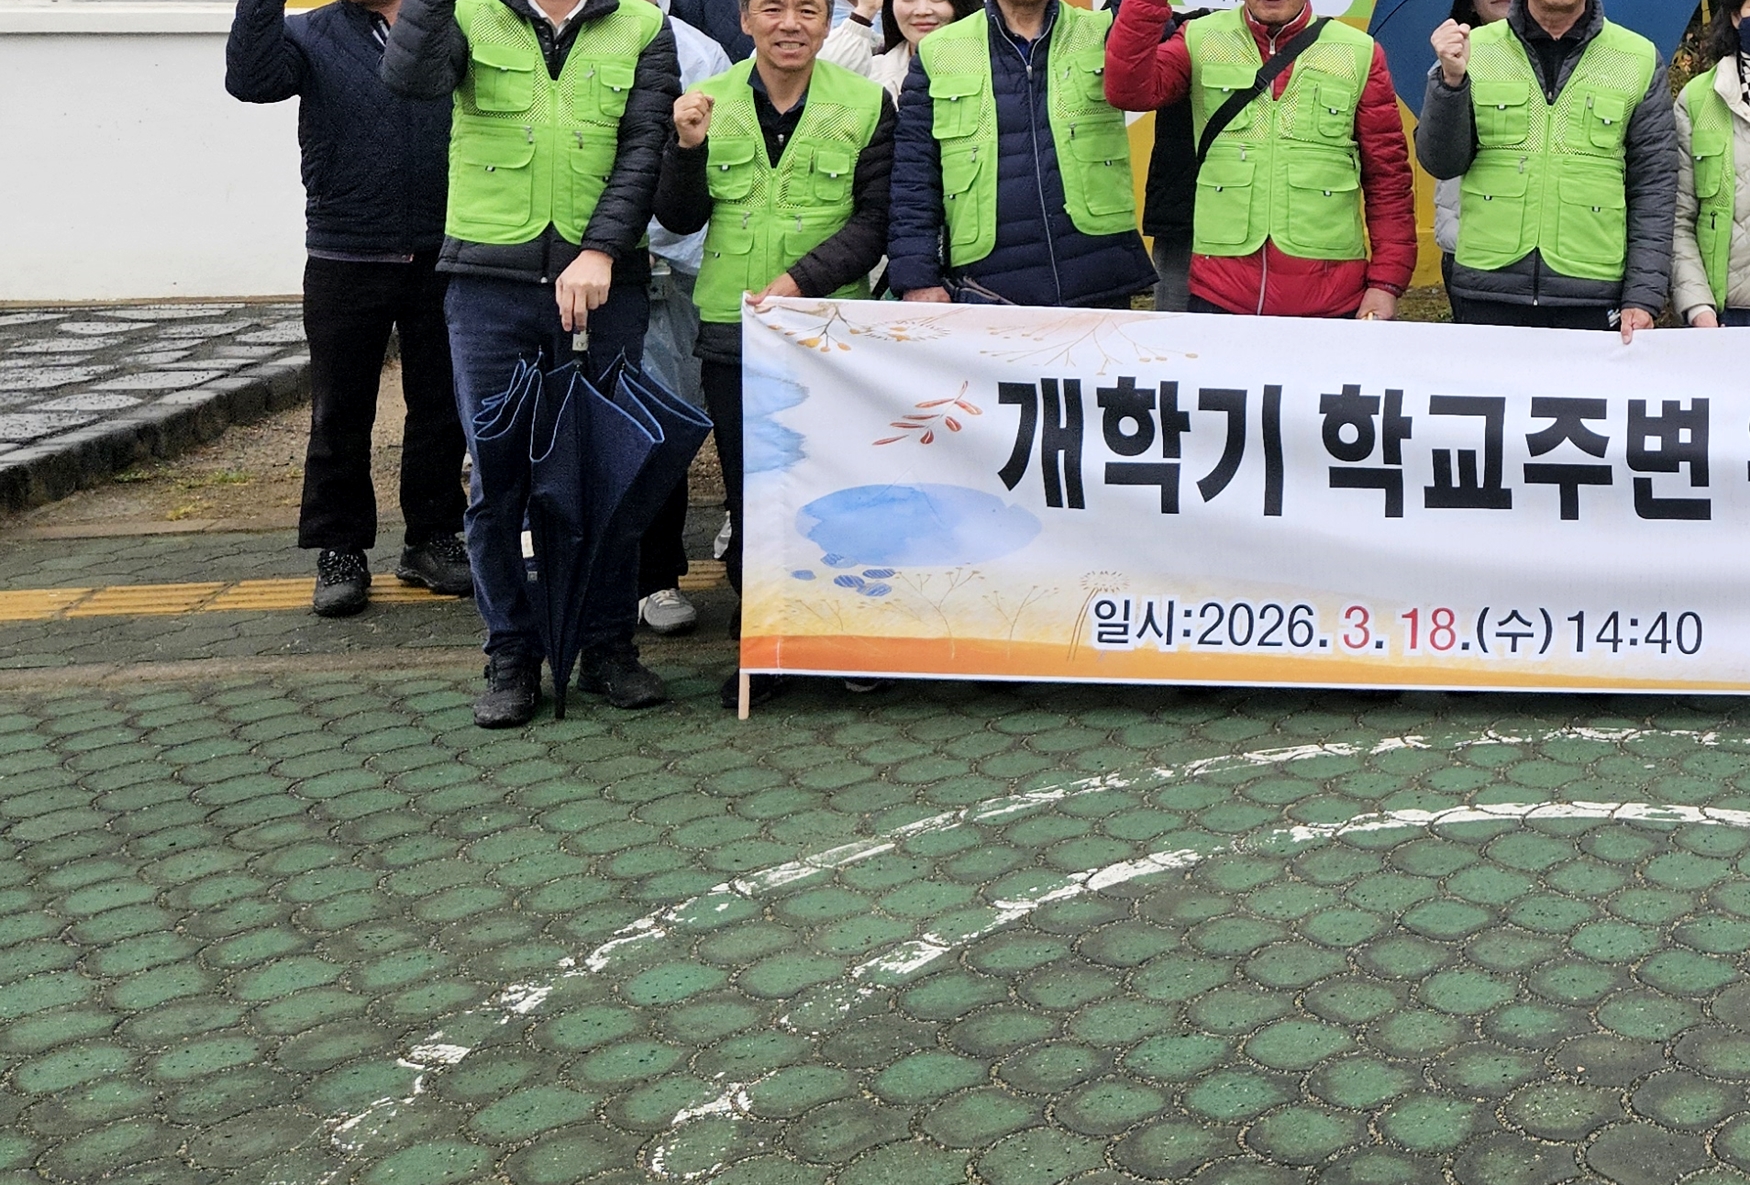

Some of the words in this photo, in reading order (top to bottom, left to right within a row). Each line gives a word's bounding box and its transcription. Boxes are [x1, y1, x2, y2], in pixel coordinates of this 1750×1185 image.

[997, 375, 1285, 518] 개학기
[1319, 384, 1713, 522] 학교주변
[1567, 610, 1705, 655] 14:40
